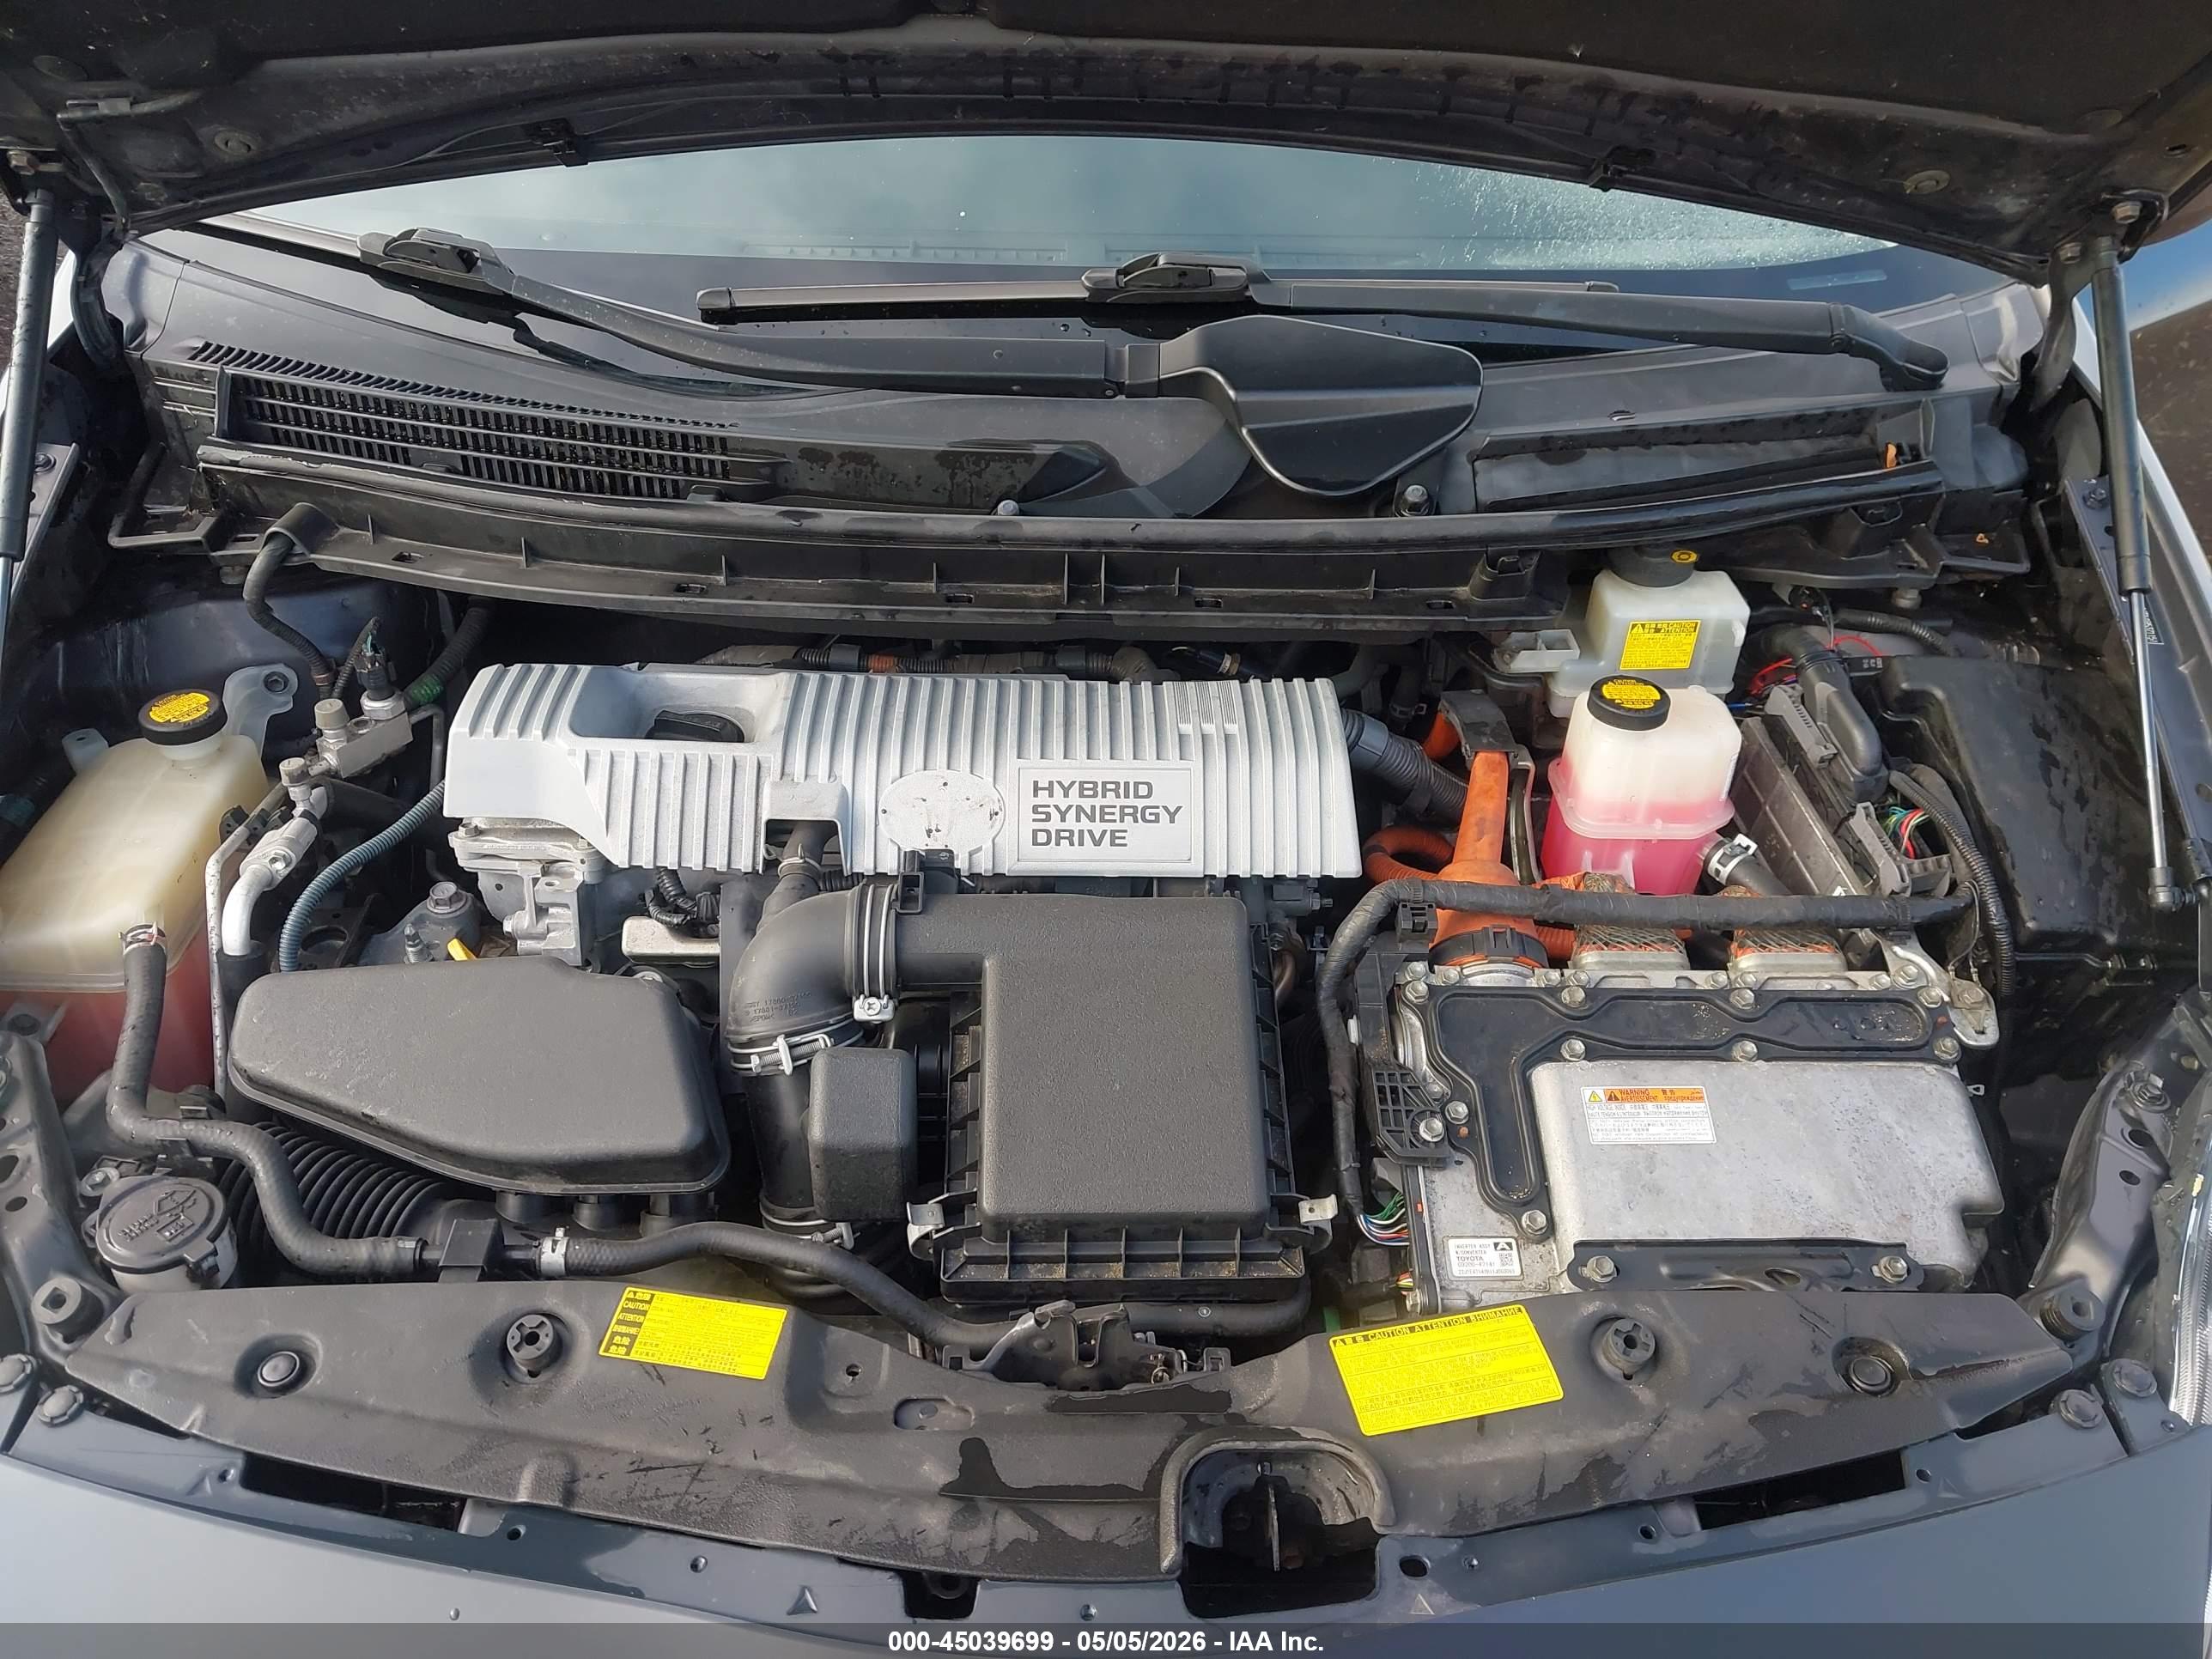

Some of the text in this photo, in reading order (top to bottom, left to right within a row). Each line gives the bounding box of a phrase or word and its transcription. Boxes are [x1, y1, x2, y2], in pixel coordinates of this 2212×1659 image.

[1032, 781, 1154, 799] HYBRID
[1032, 805, 1183, 824] SYNERGY
[1032, 829, 1128, 848] DRIVE
[623, 1300, 652, 1311] CAUTION
[617, 1312, 646, 1323] ATTENTION
[1471, 1307, 1522, 1324] ВНИМАНИЕ
[1368, 1327, 1411, 1341] CAUTION
[1414, 1316, 1468, 1334] ATTENTION
